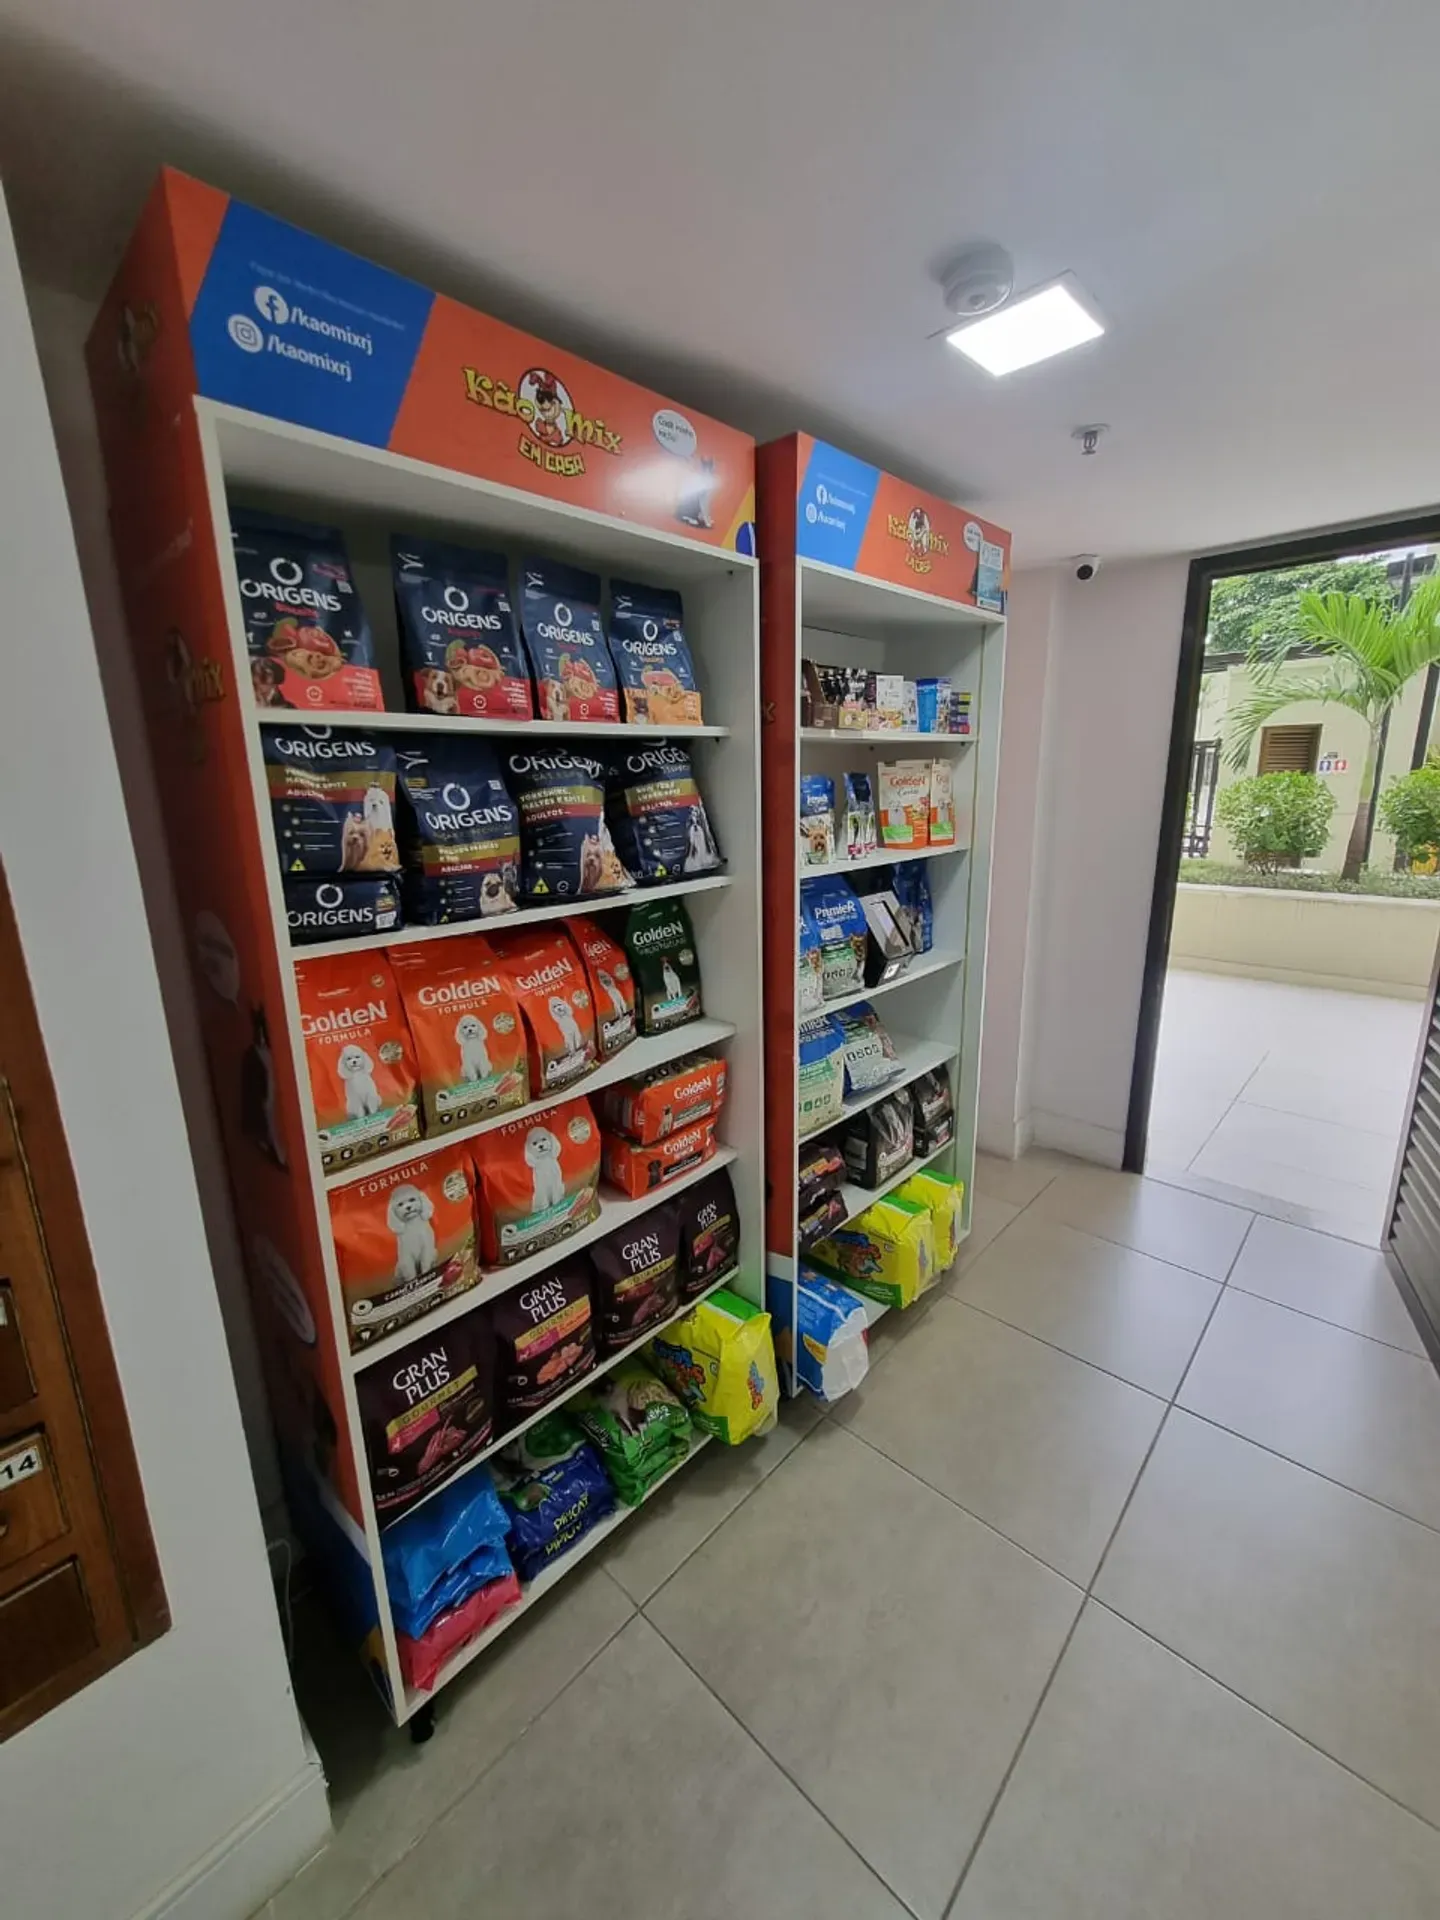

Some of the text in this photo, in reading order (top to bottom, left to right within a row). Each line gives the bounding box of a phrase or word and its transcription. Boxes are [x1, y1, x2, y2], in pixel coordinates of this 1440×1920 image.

[290, 306, 373, 356] /kaomixrj
[267, 335, 352, 382] /kaomixrj
[240, 579, 341, 612] ORIGENS
[421, 606, 501, 630] ORIGENS
[537, 622, 594, 648] ORIGENS
[623, 639, 677, 656] ORIGENS
[274, 737, 376, 759] ORIGENS
[425, 805, 512, 831] ORIGENS
[288, 907, 373, 927] ORIGENS
[438, 1000, 488, 1015] FORMULA
[318, 1028, 372, 1045] FORMULA
[359, 1161, 429, 1197] FORMULA
[622, 1233, 660, 1261] GRAN
[630, 1248, 661, 1273] PLUS
[520, 1276, 564, 1311] GRAN
[531, 1293, 567, 1323] PLUS
[392, 1347, 449, 1391] GRAN
[405, 1364, 450, 1406] PLUS
[401, 1380, 460, 1425] GOURMET
